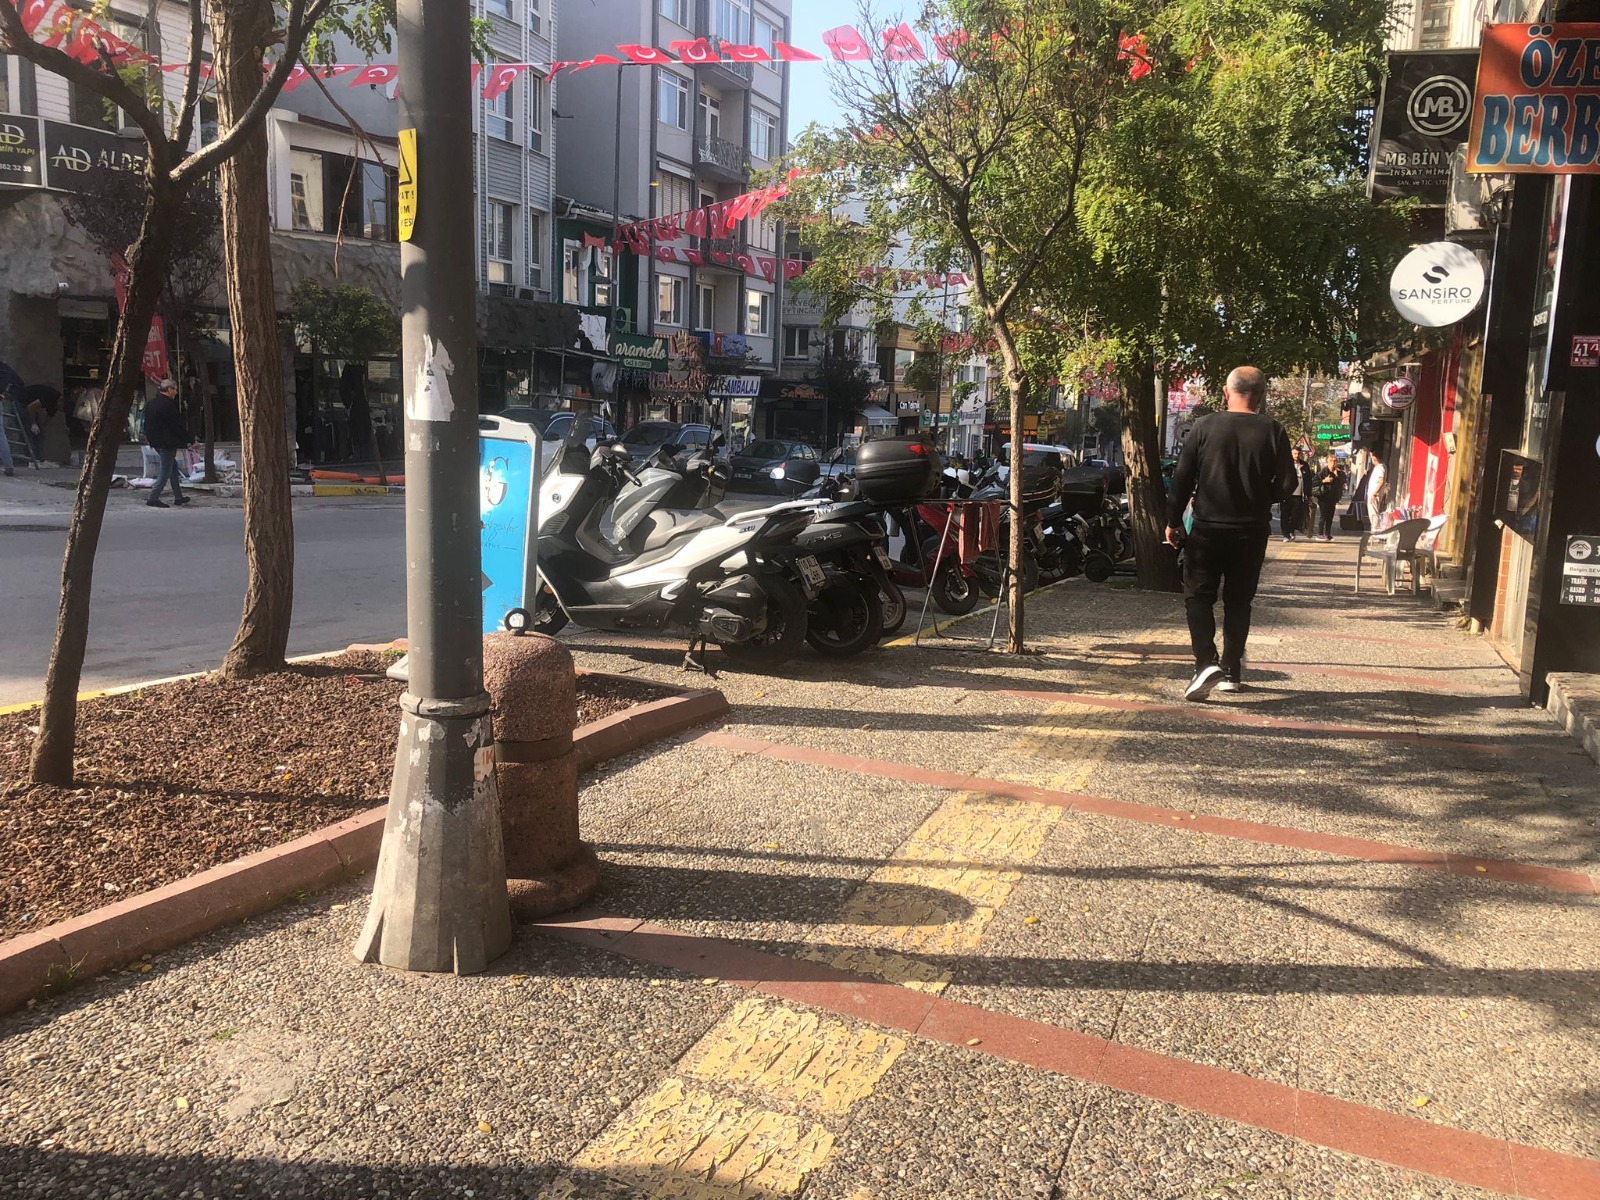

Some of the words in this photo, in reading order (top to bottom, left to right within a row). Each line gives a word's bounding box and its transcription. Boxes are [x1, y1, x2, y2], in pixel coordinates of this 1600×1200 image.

[16, 147, 35, 155] YAPI
[1384, 152, 1407, 166] MB
[1411, 148, 1440, 166] BİN
[1389, 167, 1423, 178] İNŞAAT
[726, 378, 759, 396] AMBALAJ
